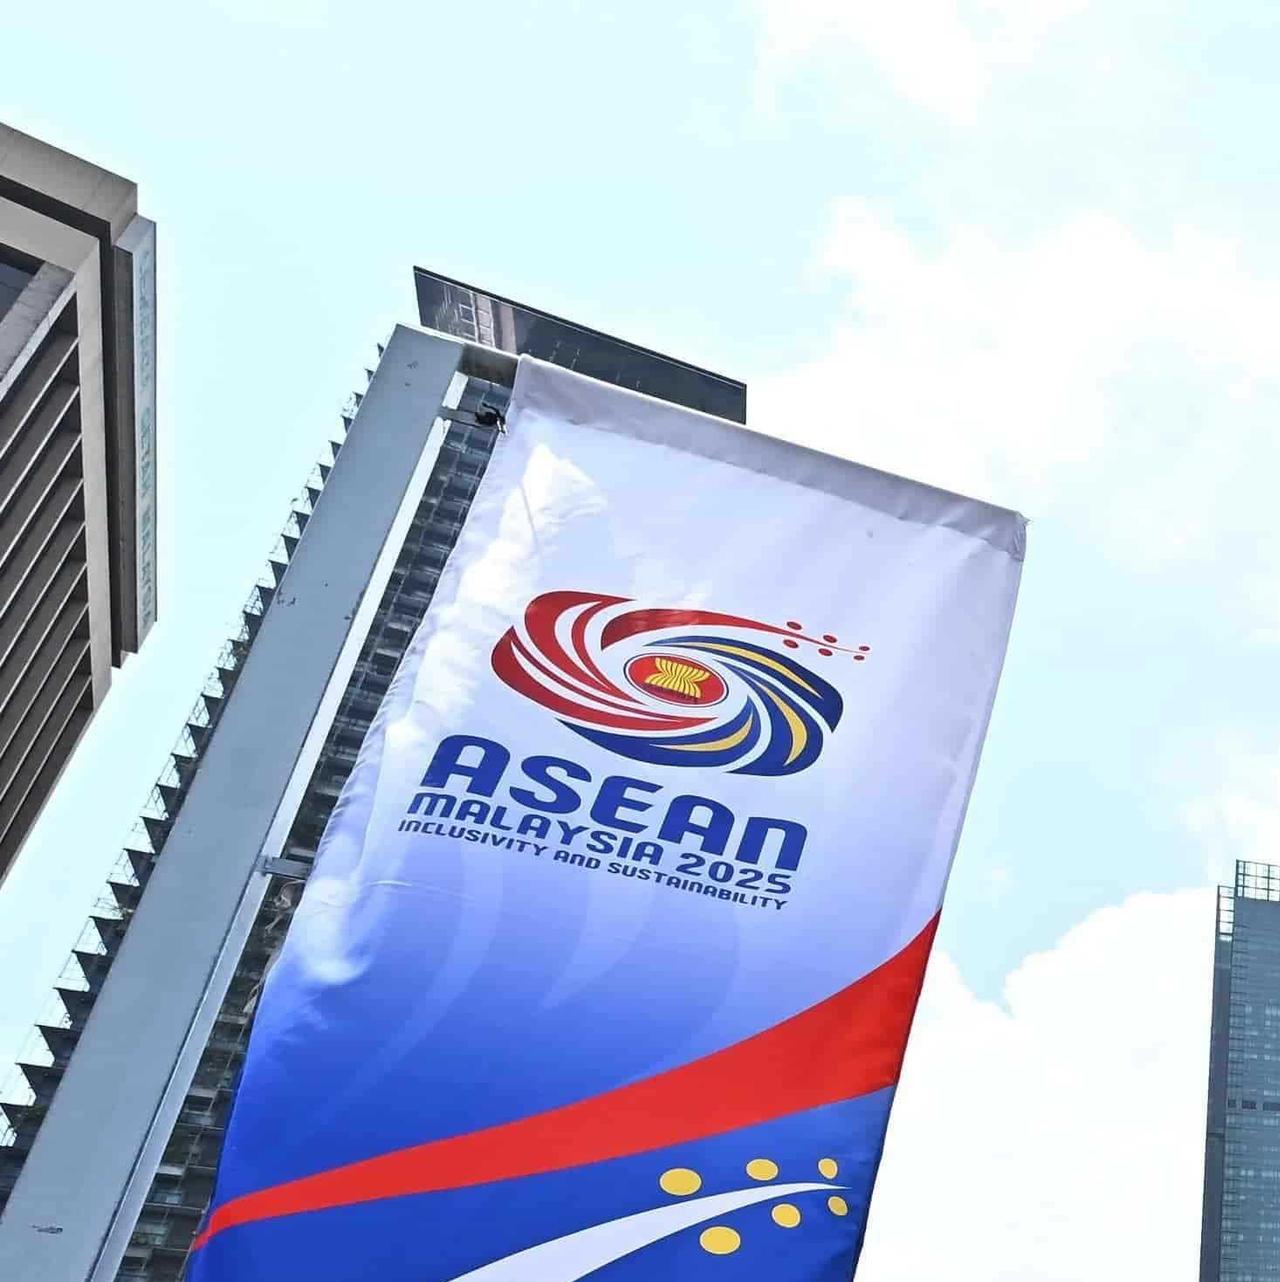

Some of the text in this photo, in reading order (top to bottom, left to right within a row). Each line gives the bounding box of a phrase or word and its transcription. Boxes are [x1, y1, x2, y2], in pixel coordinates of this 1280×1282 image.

[407, 793, 791, 894] MALAYSIA 2025
[421, 735, 807, 871] ASEAN
[398, 819, 787, 910] INCLUSIVITY AND SUSTAINABILITY
